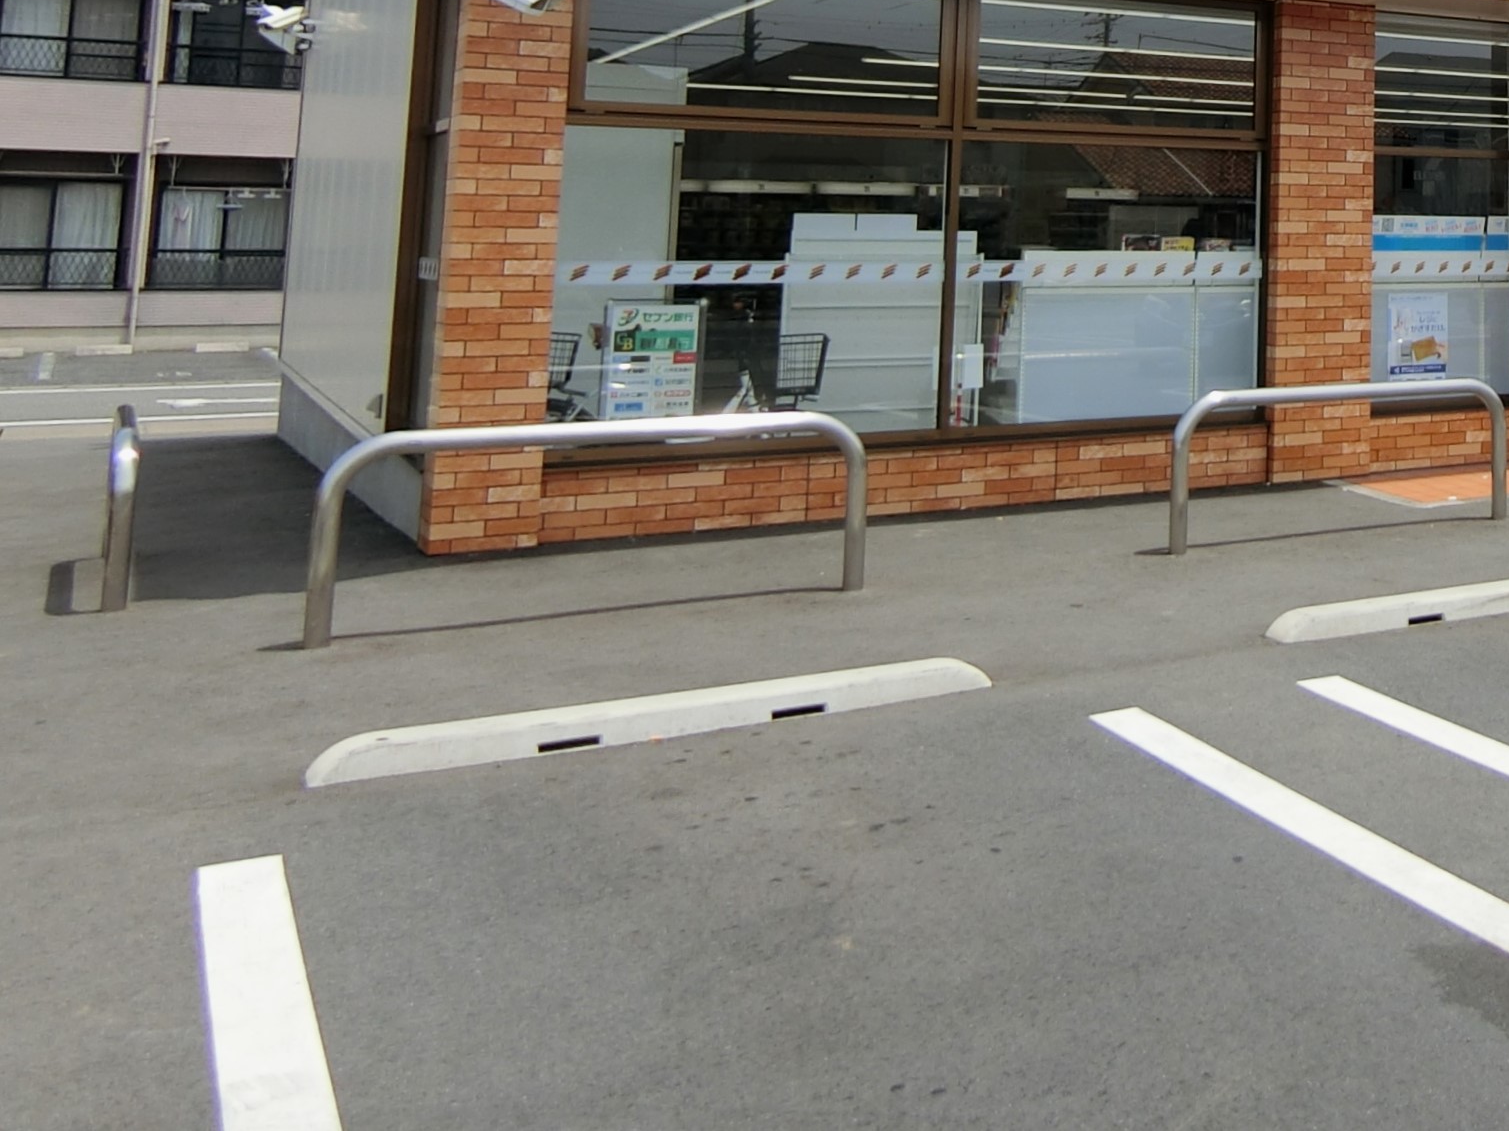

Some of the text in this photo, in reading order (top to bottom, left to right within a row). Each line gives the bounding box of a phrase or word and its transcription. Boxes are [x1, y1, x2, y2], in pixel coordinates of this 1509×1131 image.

[643, 312, 694, 323] セブン銀行
